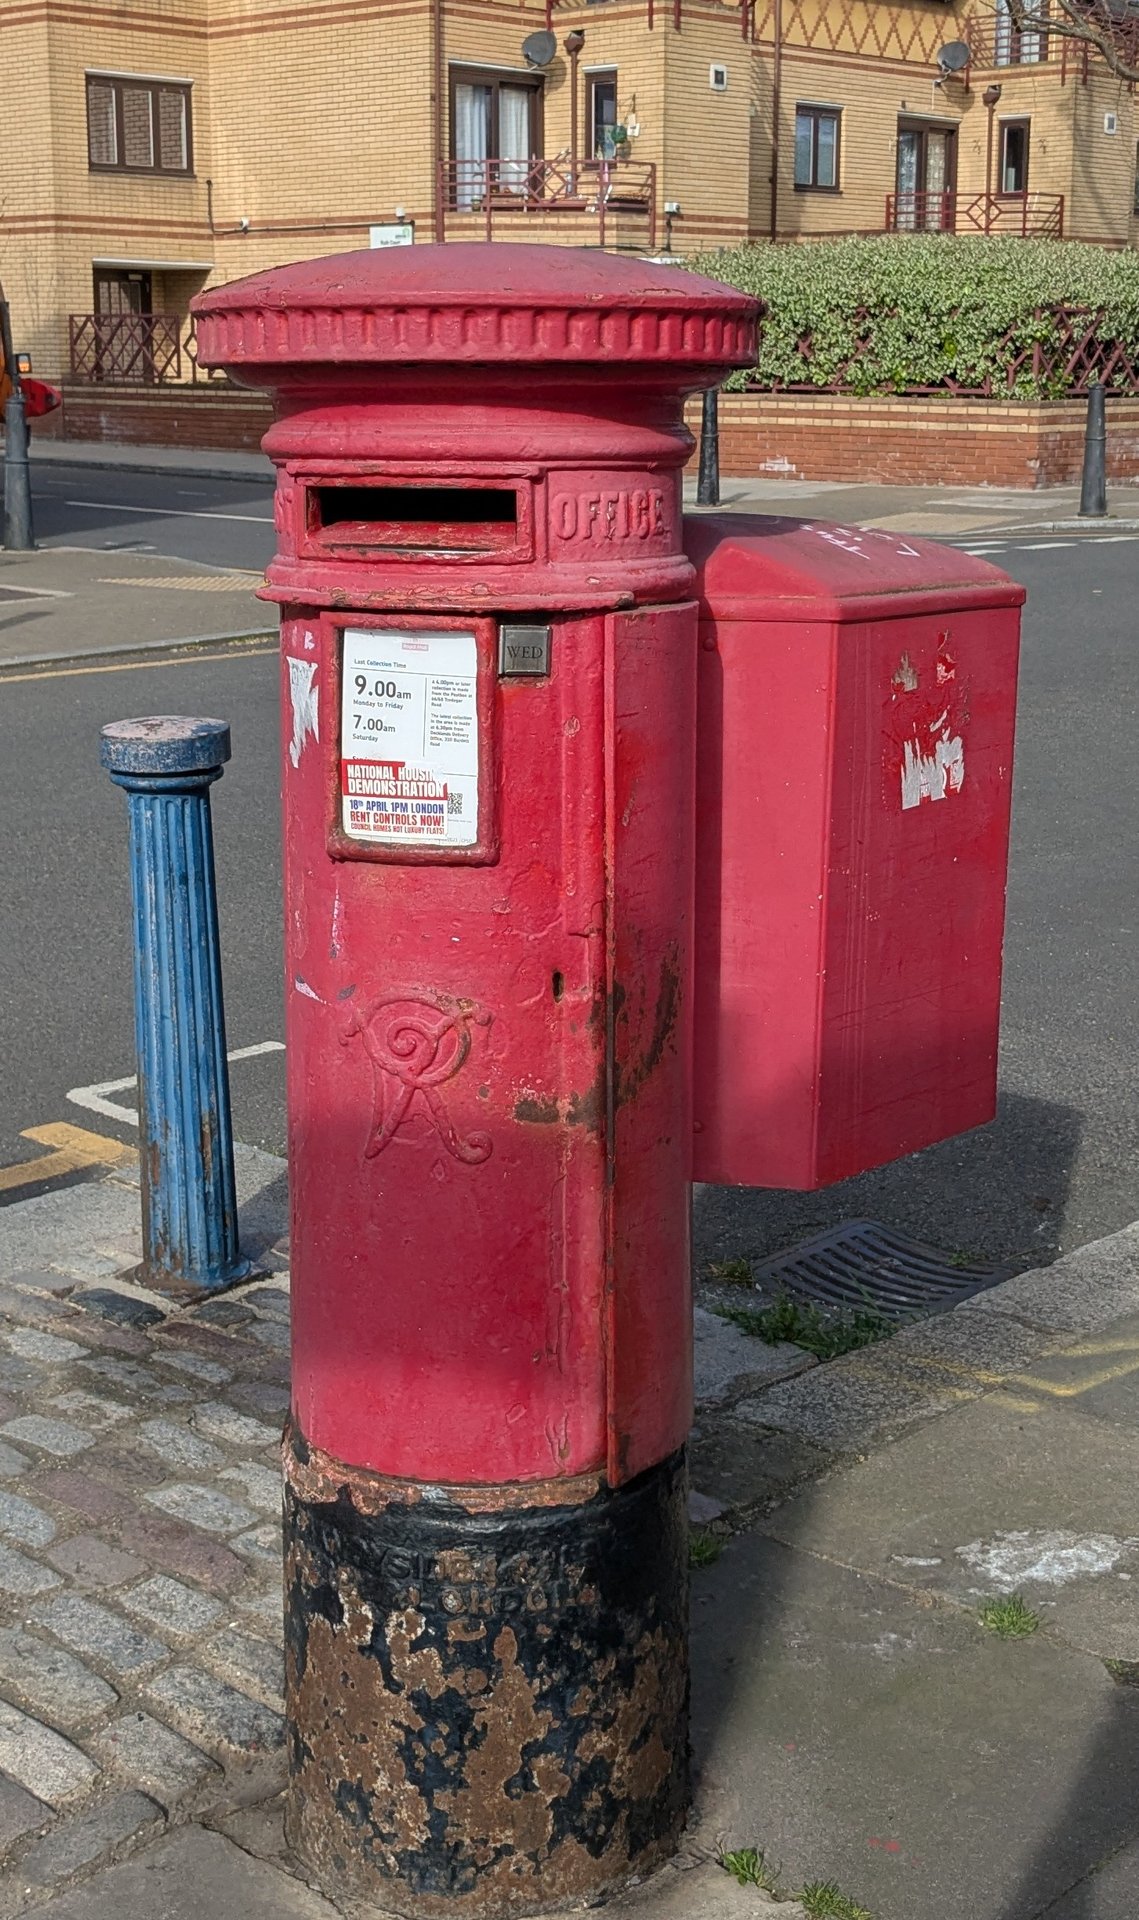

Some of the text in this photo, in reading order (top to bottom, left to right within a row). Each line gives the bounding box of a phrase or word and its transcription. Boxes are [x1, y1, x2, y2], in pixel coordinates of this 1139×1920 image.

[554, 488, 666, 539] OFFICE
[507, 646, 543, 659] WED
[366, 659, 392, 667] Collection
[354, 674, 412, 699] 9.00am
[353, 699, 375, 708] Monday
[385, 702, 404, 710] Friday
[353, 714, 396, 732] 7.00am
[352, 733, 378, 742] Saturday
[347, 764, 395, 780] NATIONAL
[348, 779, 444, 798] DEMONSTRATION
[350, 800, 444, 814] 18th APRIL 1PM LONDON
[350, 811, 444, 827] RENT CONTROLS NOW!
[351, 823, 444, 835] COUNCIL HOMES NOT LUXURY FLATS!
